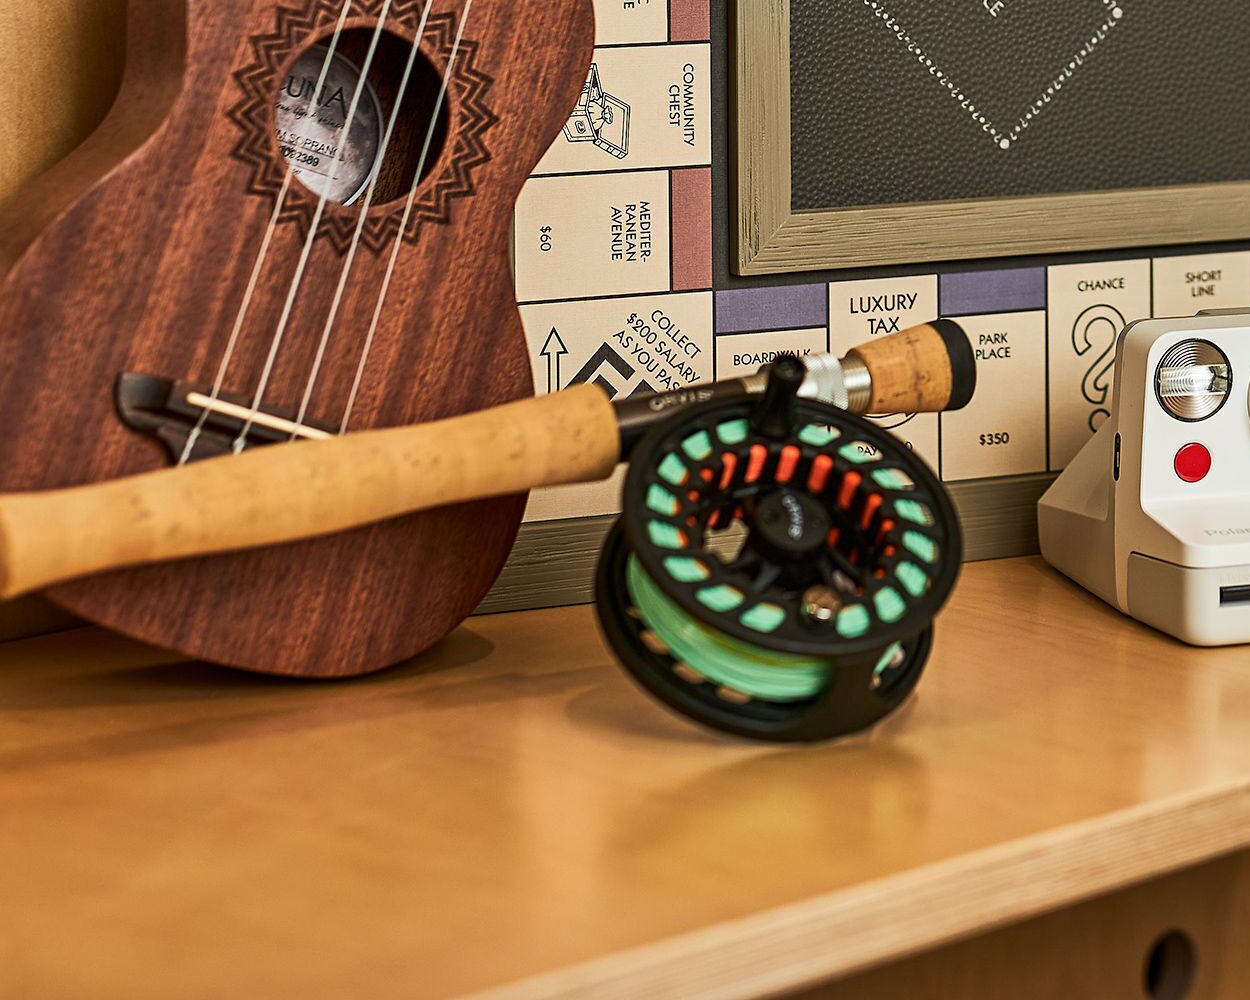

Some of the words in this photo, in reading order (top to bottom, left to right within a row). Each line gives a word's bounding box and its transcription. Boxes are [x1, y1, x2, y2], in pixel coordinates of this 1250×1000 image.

[280, 75, 347, 119] UNA
[667, 84, 681, 128] CHEST
[682, 62, 696, 148] COMMUNITY
[540, 225, 552, 252] $60
[611, 206, 623, 262] AVENUE
[625, 202, 637, 263] RANEAN
[638, 201, 650, 263] MEDITER-
[1077, 277, 1125, 292] CHANCE
[1185, 270, 1222, 284] SHORT
[1191, 284, 1216, 297] LINE
[849, 293, 918, 315] LUXURY
[651, 310, 701, 359] COLLECT
[867, 317, 900, 335] TAX
[979, 332, 1008, 346] PARK
[612, 330, 634, 348] AS
[630, 343, 660, 373] YOU
[655, 368, 685, 391] PAS
[626, 312, 657, 344] $200
[655, 340, 701, 383] SALARY
[975, 346, 1011, 360] PLACE
[979, 431, 1010, 446] $350
